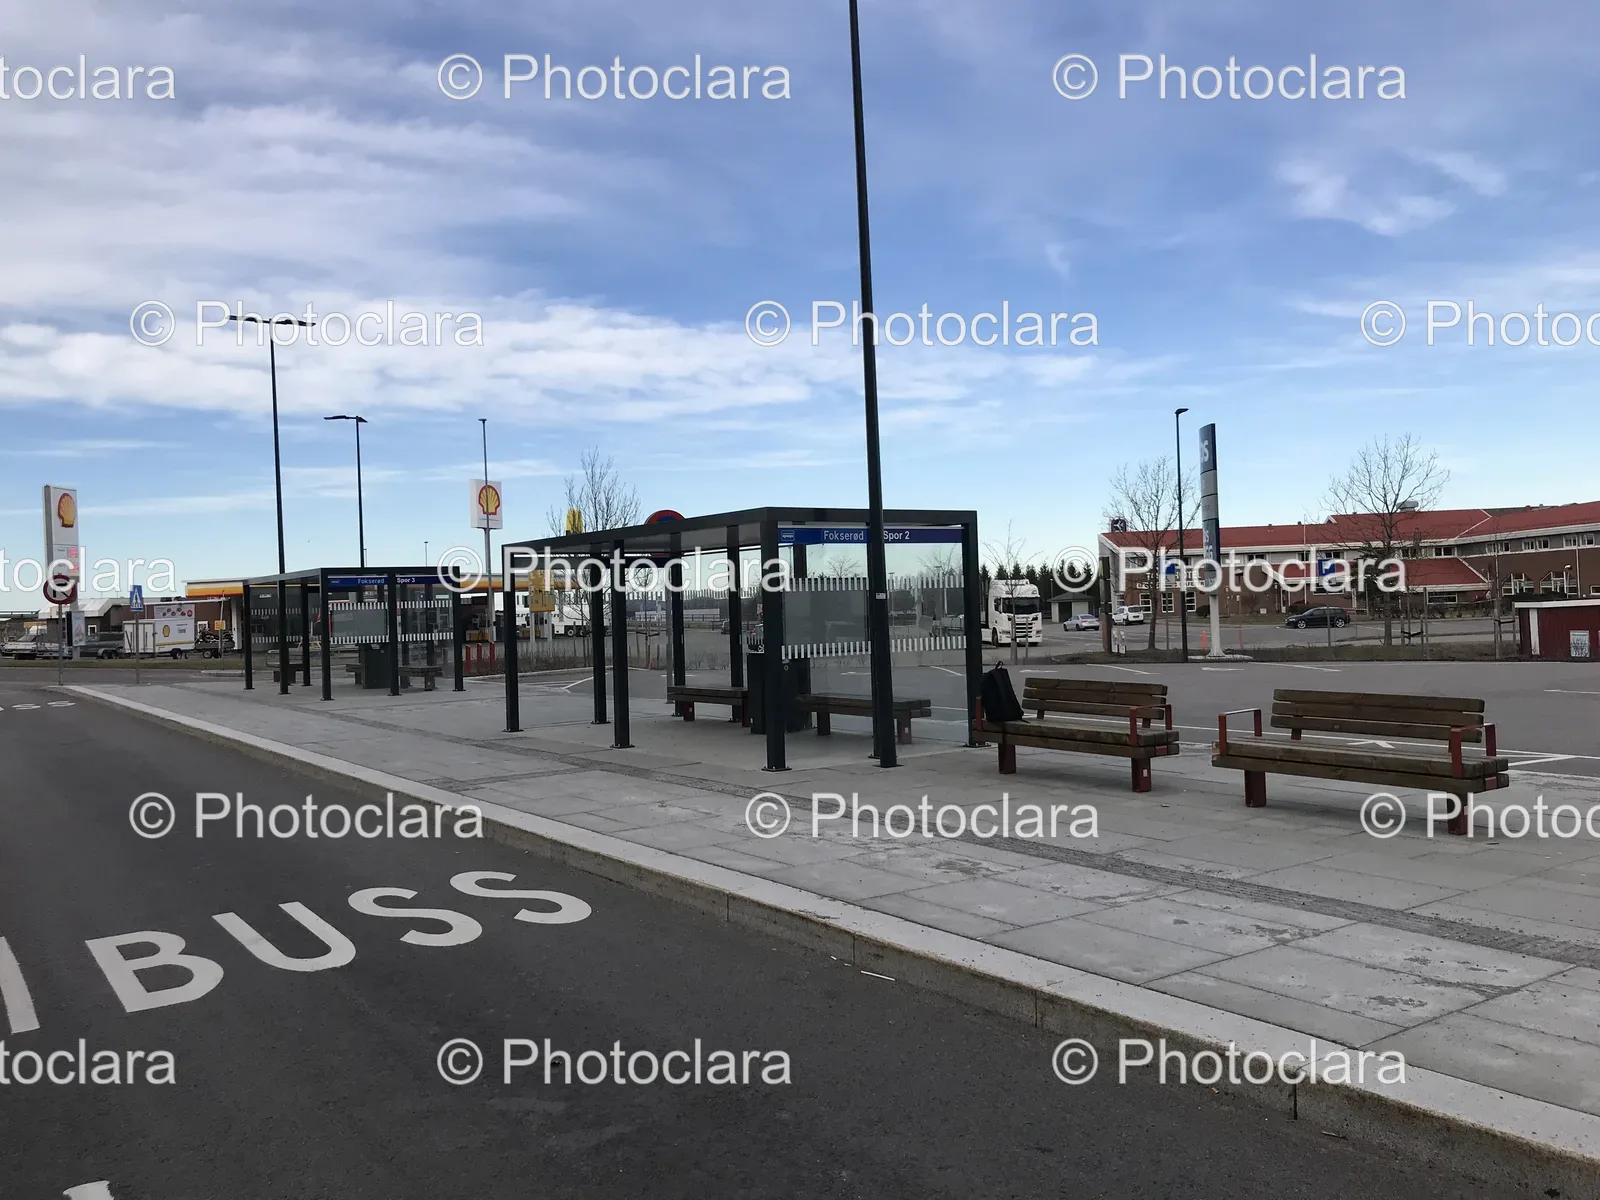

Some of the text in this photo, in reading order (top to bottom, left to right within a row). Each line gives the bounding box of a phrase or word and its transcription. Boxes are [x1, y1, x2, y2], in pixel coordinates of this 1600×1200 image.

[824, 530, 910, 542] Fokserød Spor 2
[85, 870, 592, 1013] BUSS
